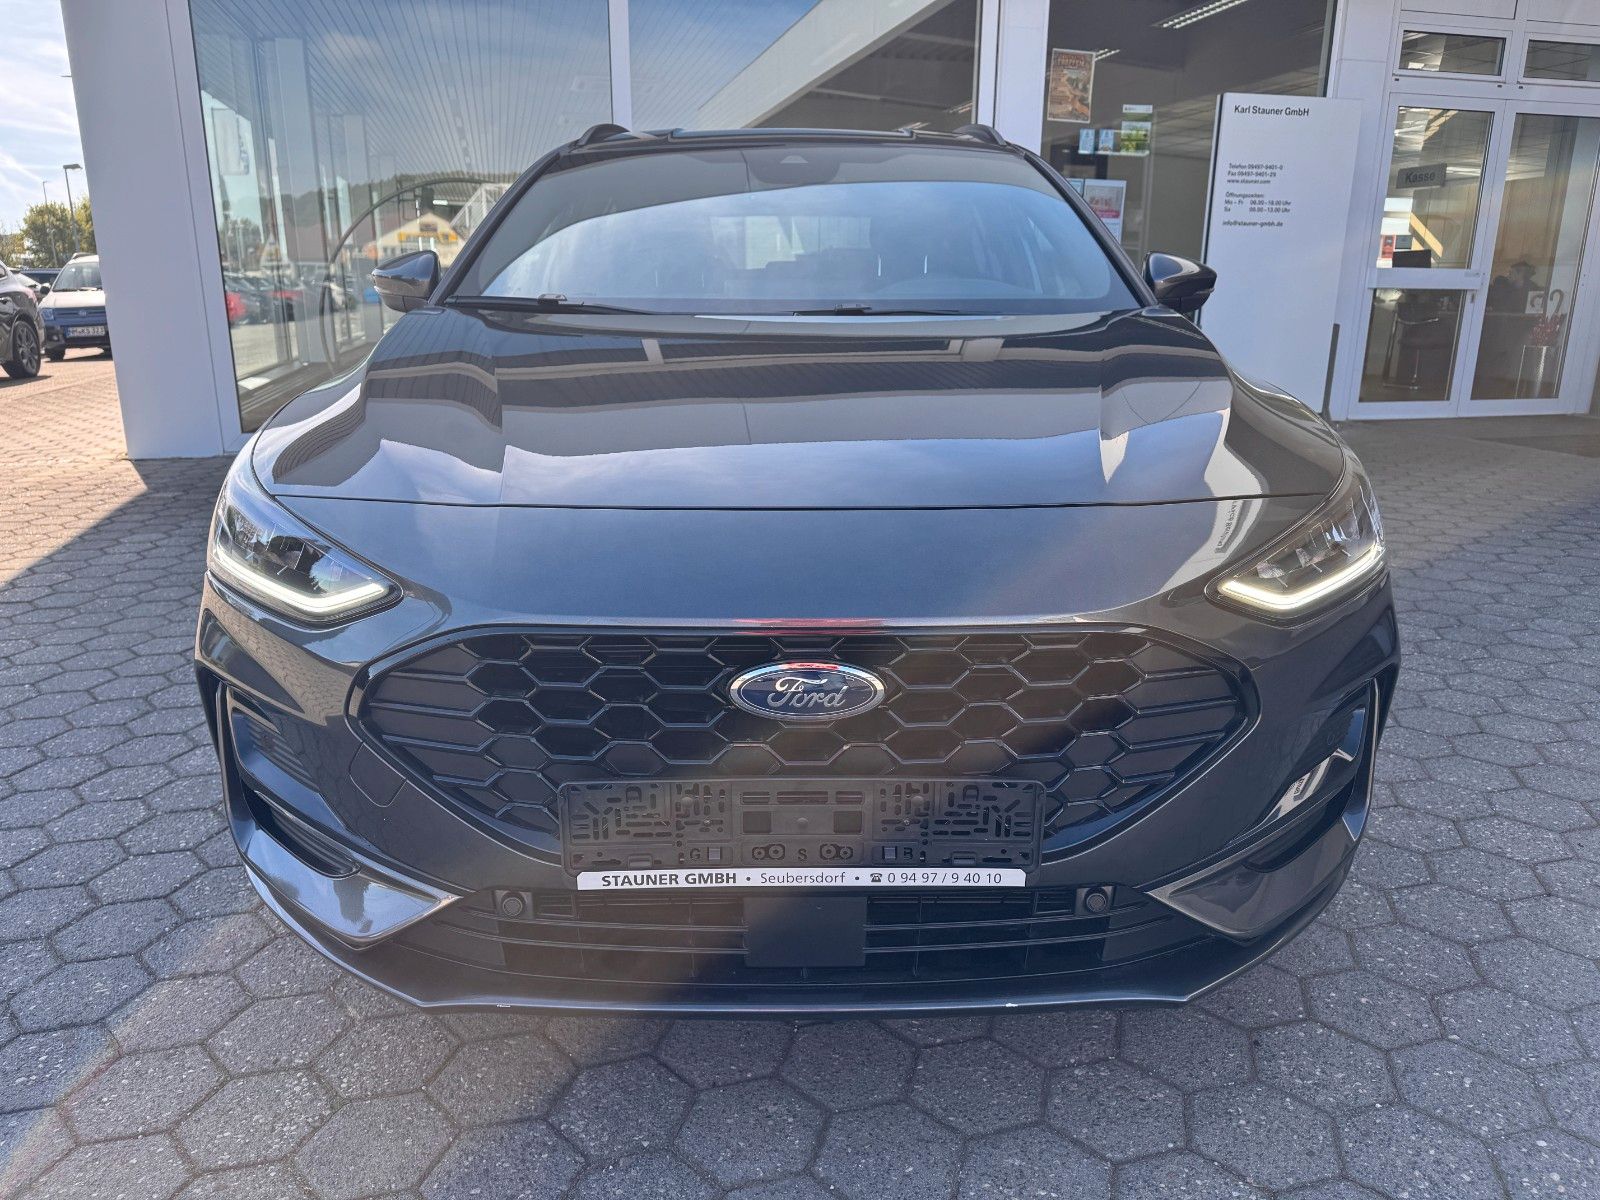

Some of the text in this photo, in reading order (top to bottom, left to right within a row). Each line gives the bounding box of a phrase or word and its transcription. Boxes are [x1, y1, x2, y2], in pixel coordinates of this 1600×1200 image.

[1234, 105, 1310, 117] Karl Stauner GmbH
[1405, 170, 1436, 183] Kasse
[1222, 220, 1284, 228] info@stauner-gmbh.de
[767, 676, 850, 708] Ford
[601, 873, 679, 887] STAUNER
[684, 872, 737, 885] GMBH
[760, 871, 846, 884] Seubersdorf
[887, 873, 896, 884] 0
[900, 873, 917, 884] 94
[921, 873, 936, 884] 97
[951, 873, 959, 884] 9
[963, 873, 981, 884] 40
[986, 873, 1002, 884] 10
